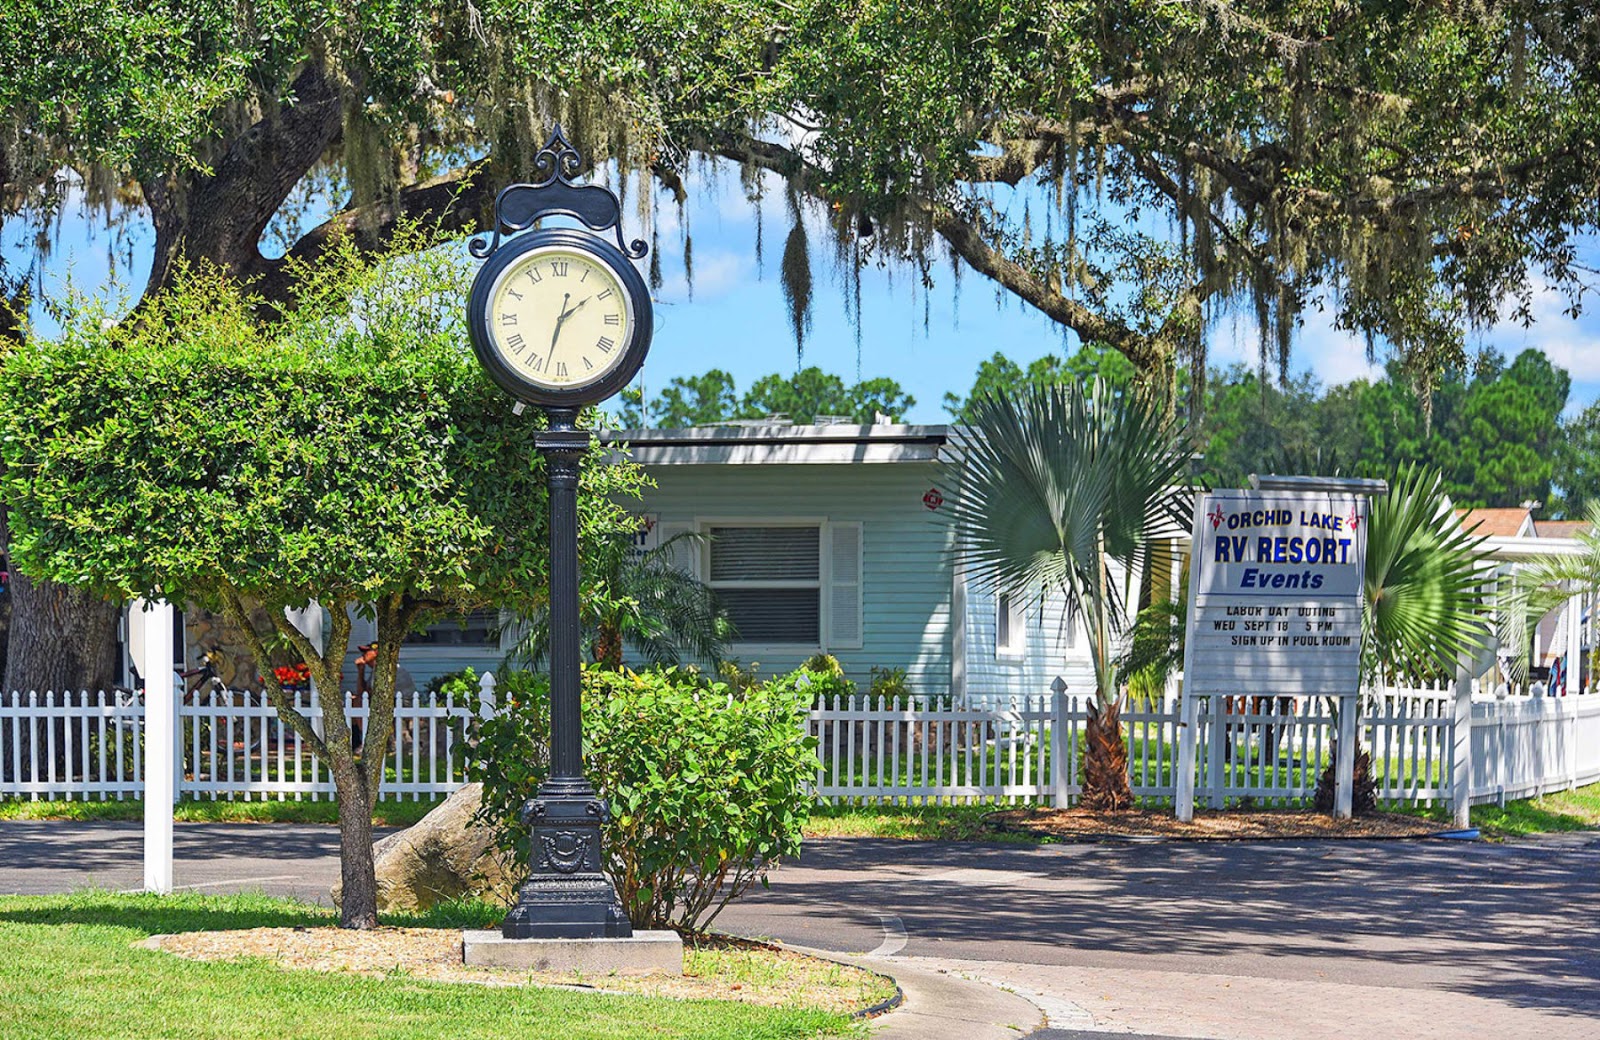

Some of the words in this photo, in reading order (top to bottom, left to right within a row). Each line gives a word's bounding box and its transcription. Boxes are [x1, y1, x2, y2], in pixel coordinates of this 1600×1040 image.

[526, 267, 543, 285] XI
[551, 262, 568, 277] XII
[580, 269, 590, 283] I
[508, 288, 524, 301] X
[597, 288, 612, 301] II
[502, 313, 517, 326] IX
[604, 314, 619, 326] III
[524, 352, 543, 372] VII
[556, 362, 568, 376] VI
[582, 356, 593, 370] V
[1227, 509, 1292, 530] ORCHID
[1300, 510, 1344, 531] LAKE
[1214, 535, 1248, 563] RV
[1257, 536, 1351, 564] RESORT
[1240, 568, 1324, 589] Events
[1226, 606, 1263, 617] LABOR
[1268, 606, 1290, 617] DAY
[1298, 607, 1336, 617] OUTING
[1214, 620, 1236, 631] WED
[1244, 620, 1271, 631] SEPT
[1277, 621, 1289, 631] 18
[1305, 621, 1312, 631] 5
[1317, 621, 1333, 631] PM
[1231, 635, 1257, 646] SIGN
[1260, 635, 1274, 646] UP
[1277, 635, 1289, 646] IN
[1293, 636, 1319, 646] POOL
[1322, 636, 1351, 646] ROOM
